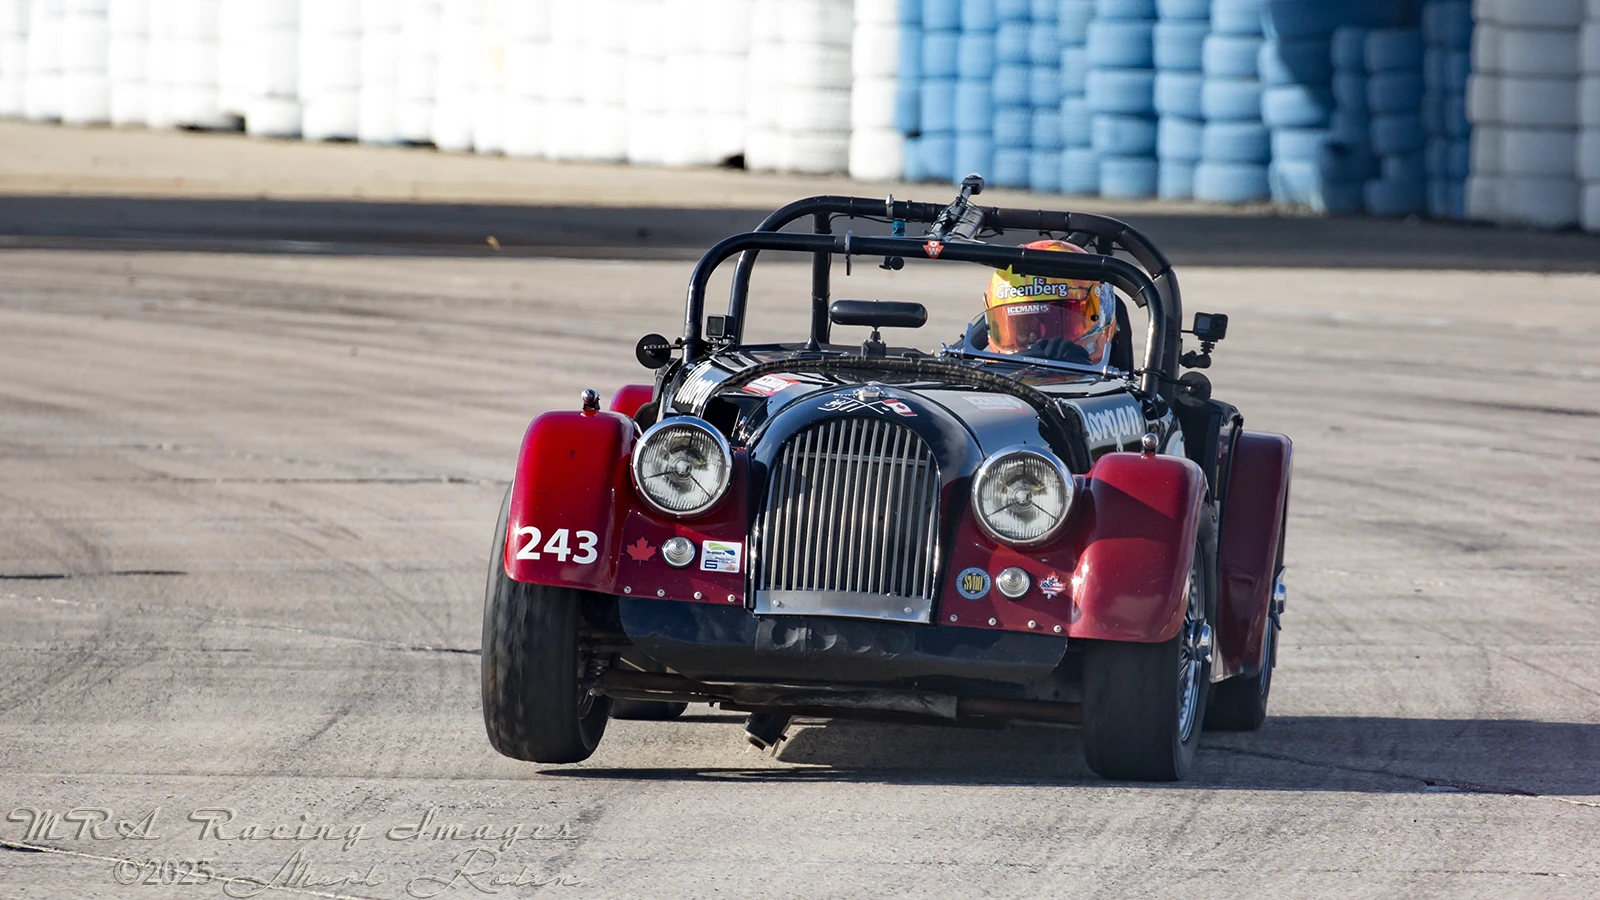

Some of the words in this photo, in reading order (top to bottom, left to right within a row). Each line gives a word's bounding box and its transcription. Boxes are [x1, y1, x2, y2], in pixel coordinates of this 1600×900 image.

[995, 278, 1068, 299] Greenberg
[1007, 305, 1040, 314] ICEMAN
[515, 526, 599, 565] 243
